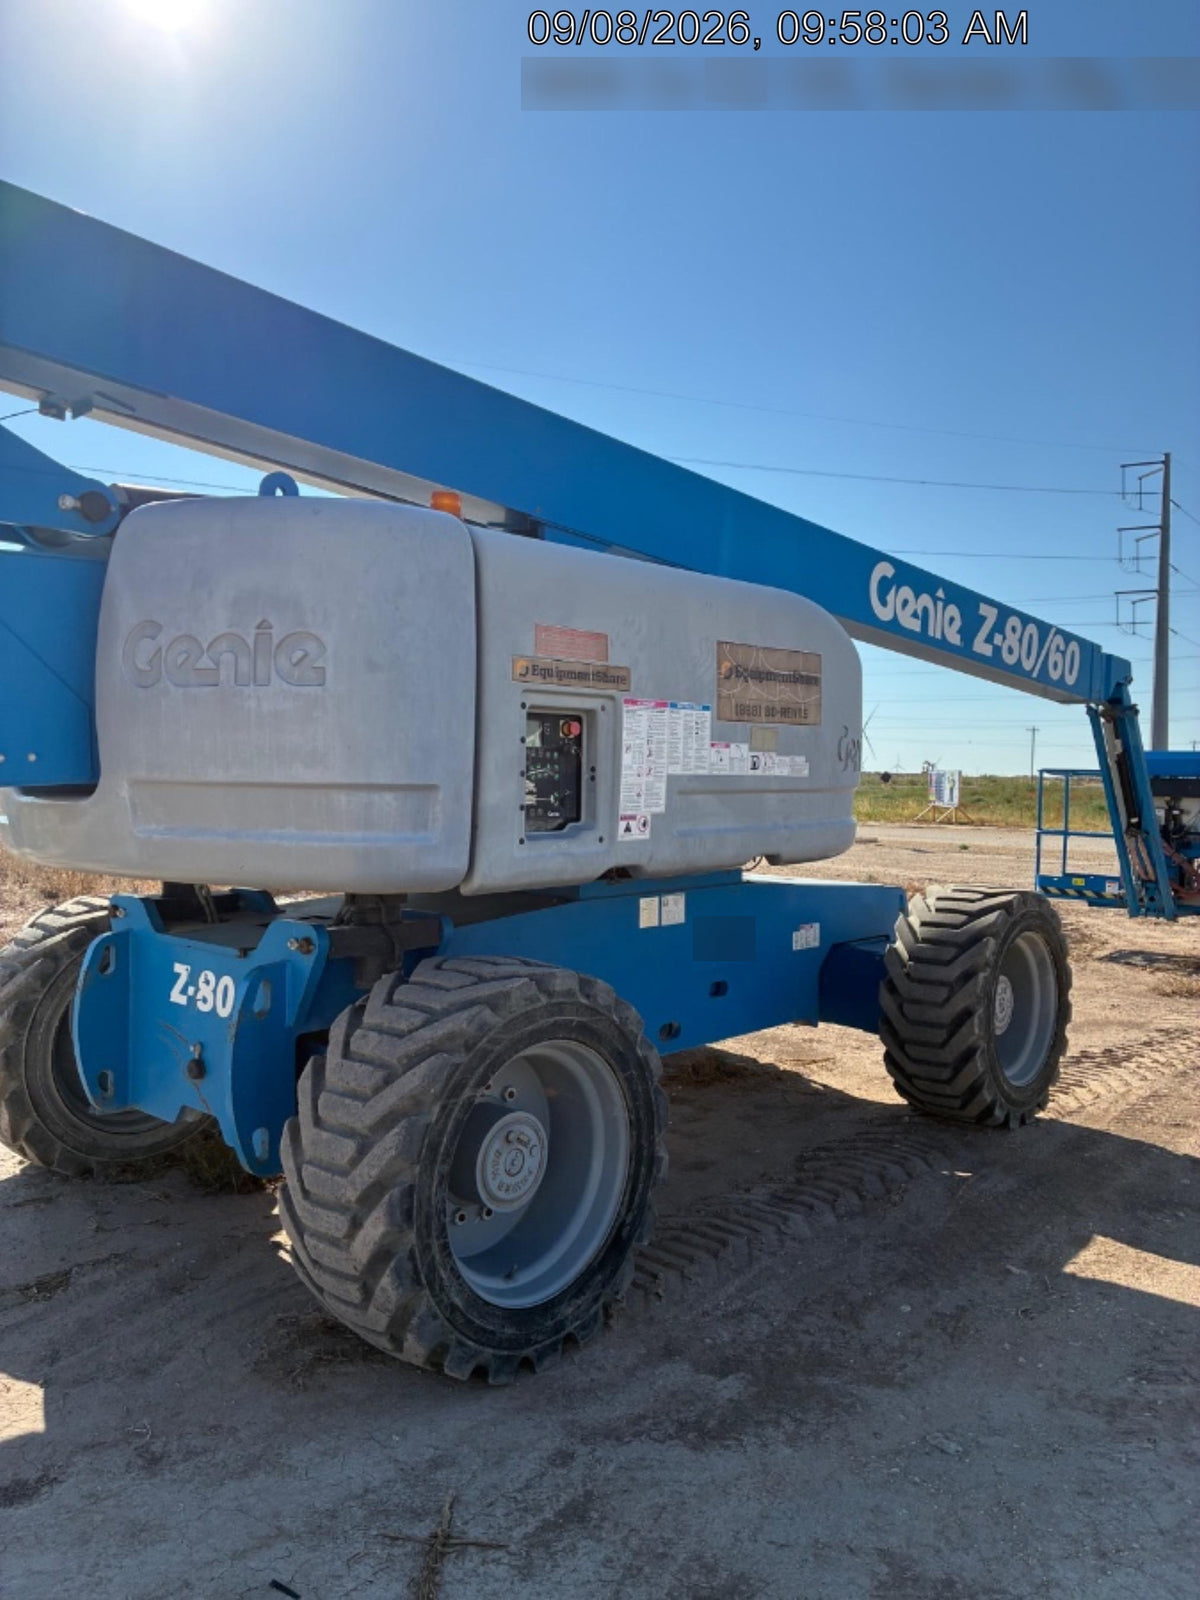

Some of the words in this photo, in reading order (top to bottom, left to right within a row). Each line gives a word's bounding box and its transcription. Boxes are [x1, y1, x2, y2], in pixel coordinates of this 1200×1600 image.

[122, 618, 327, 688] Genie
[869, 561, 963, 647] Genie
[972, 602, 1080, 686] Z-80/60
[531, 664, 627, 685] EquipmentShare
[169, 962, 235, 1018] Z-80
